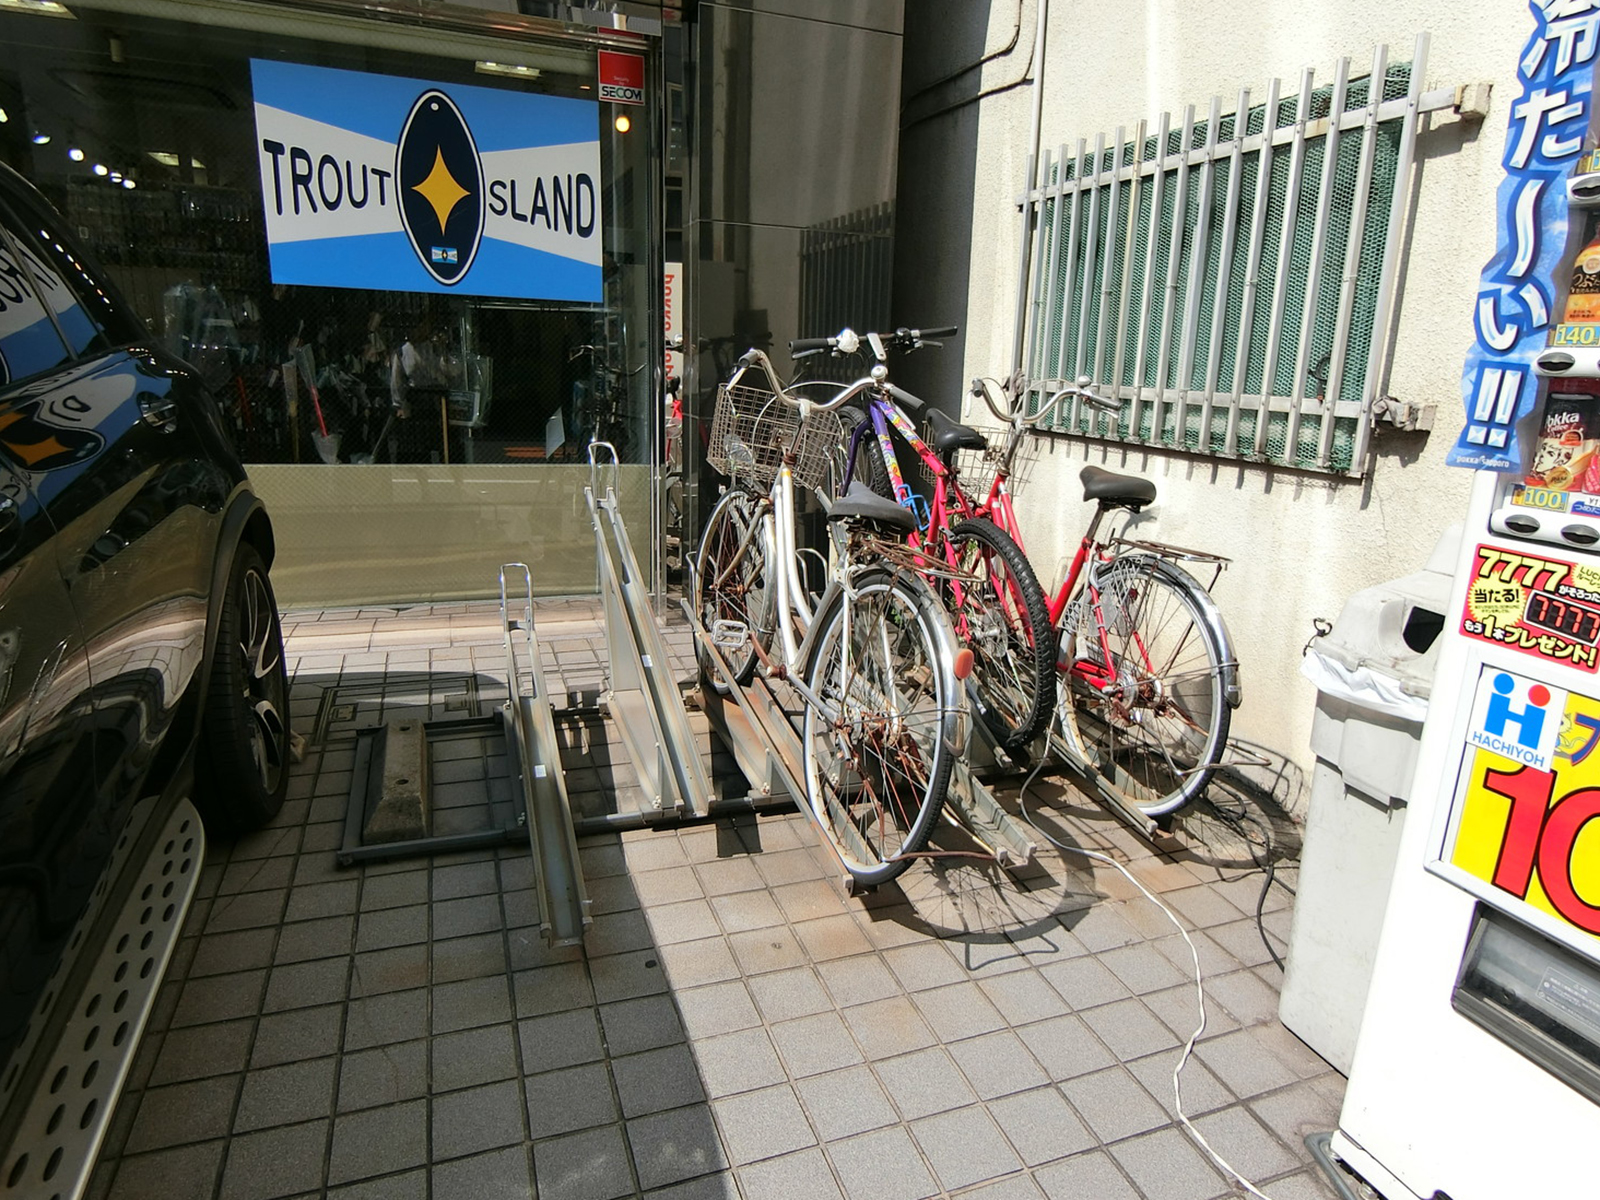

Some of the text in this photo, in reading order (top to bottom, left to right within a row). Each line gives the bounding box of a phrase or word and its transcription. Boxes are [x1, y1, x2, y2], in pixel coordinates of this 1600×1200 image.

[601, 86, 642, 101] SECOM
[262, 138, 392, 217] TROUT
[1478, 546, 1571, 594] 7777
[1472, 731, 1545, 768] HACHIYOH
